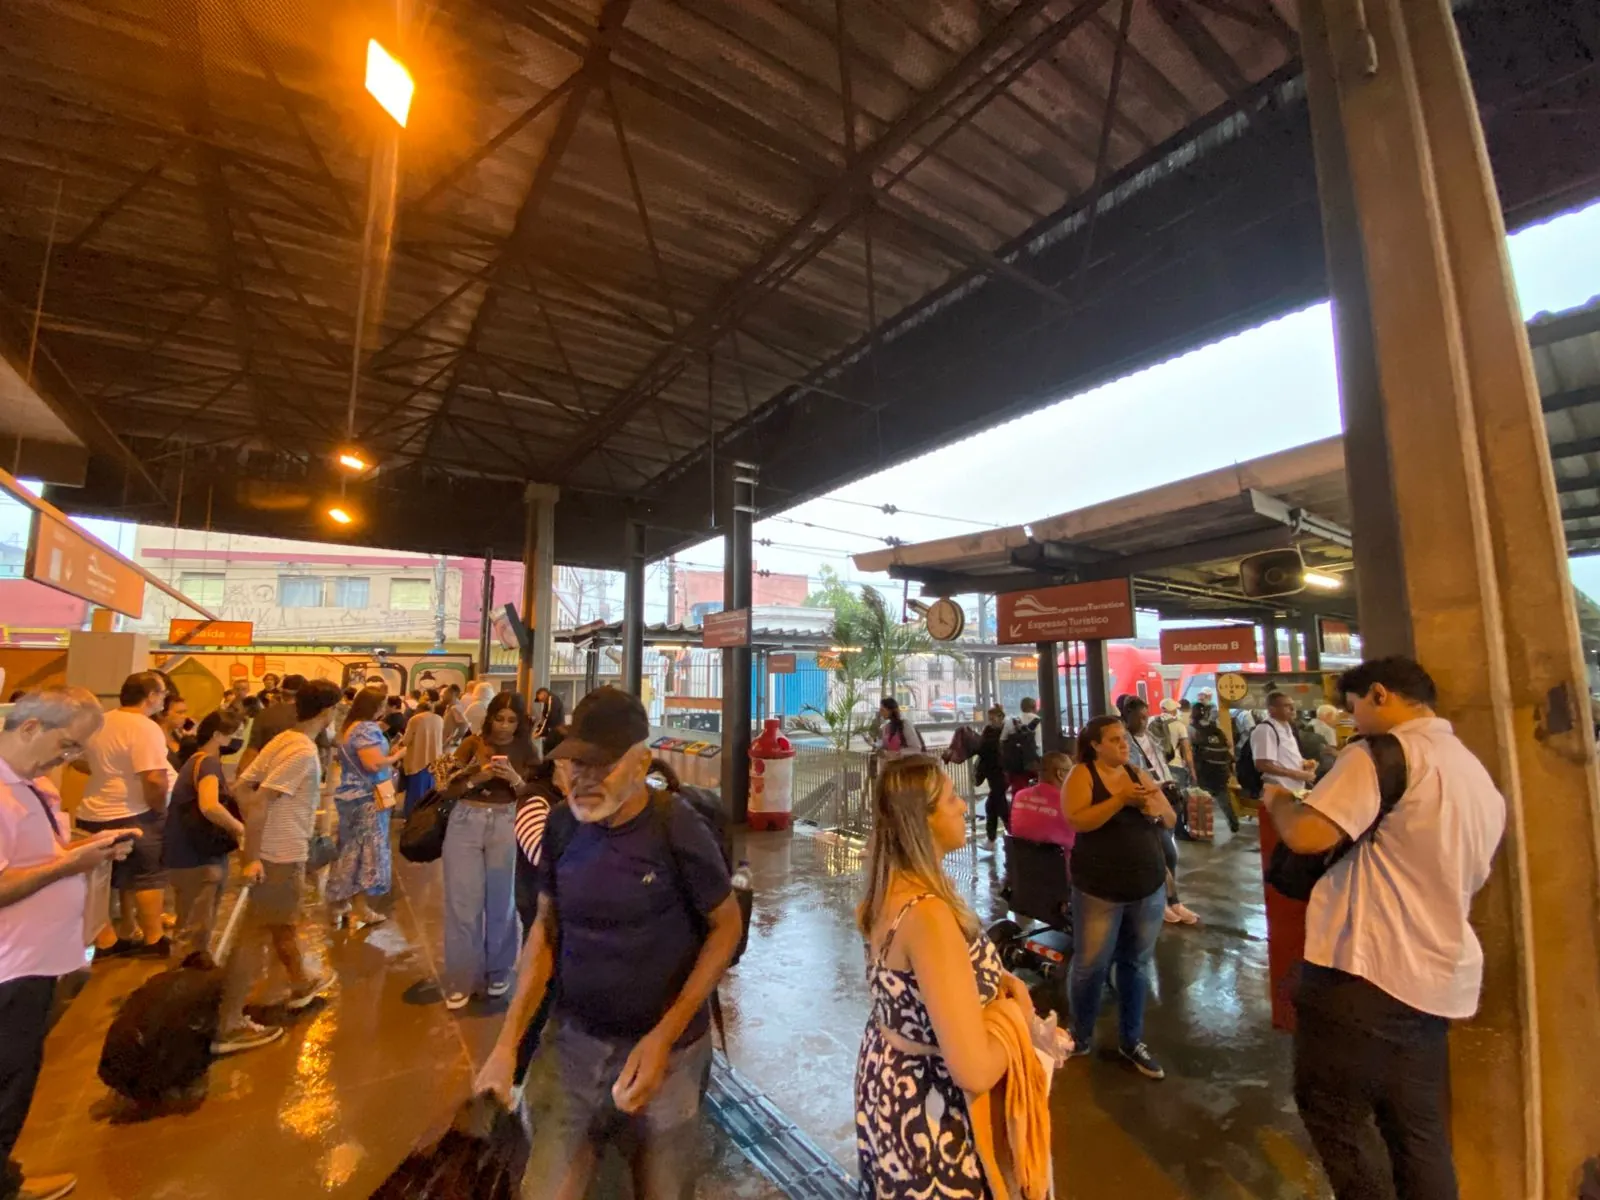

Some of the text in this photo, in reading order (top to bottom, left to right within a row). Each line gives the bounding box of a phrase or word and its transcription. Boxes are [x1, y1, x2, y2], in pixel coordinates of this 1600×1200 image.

[1027, 620, 1067, 630] Expresso
[1173, 640, 1240, 652] Plataforma B
